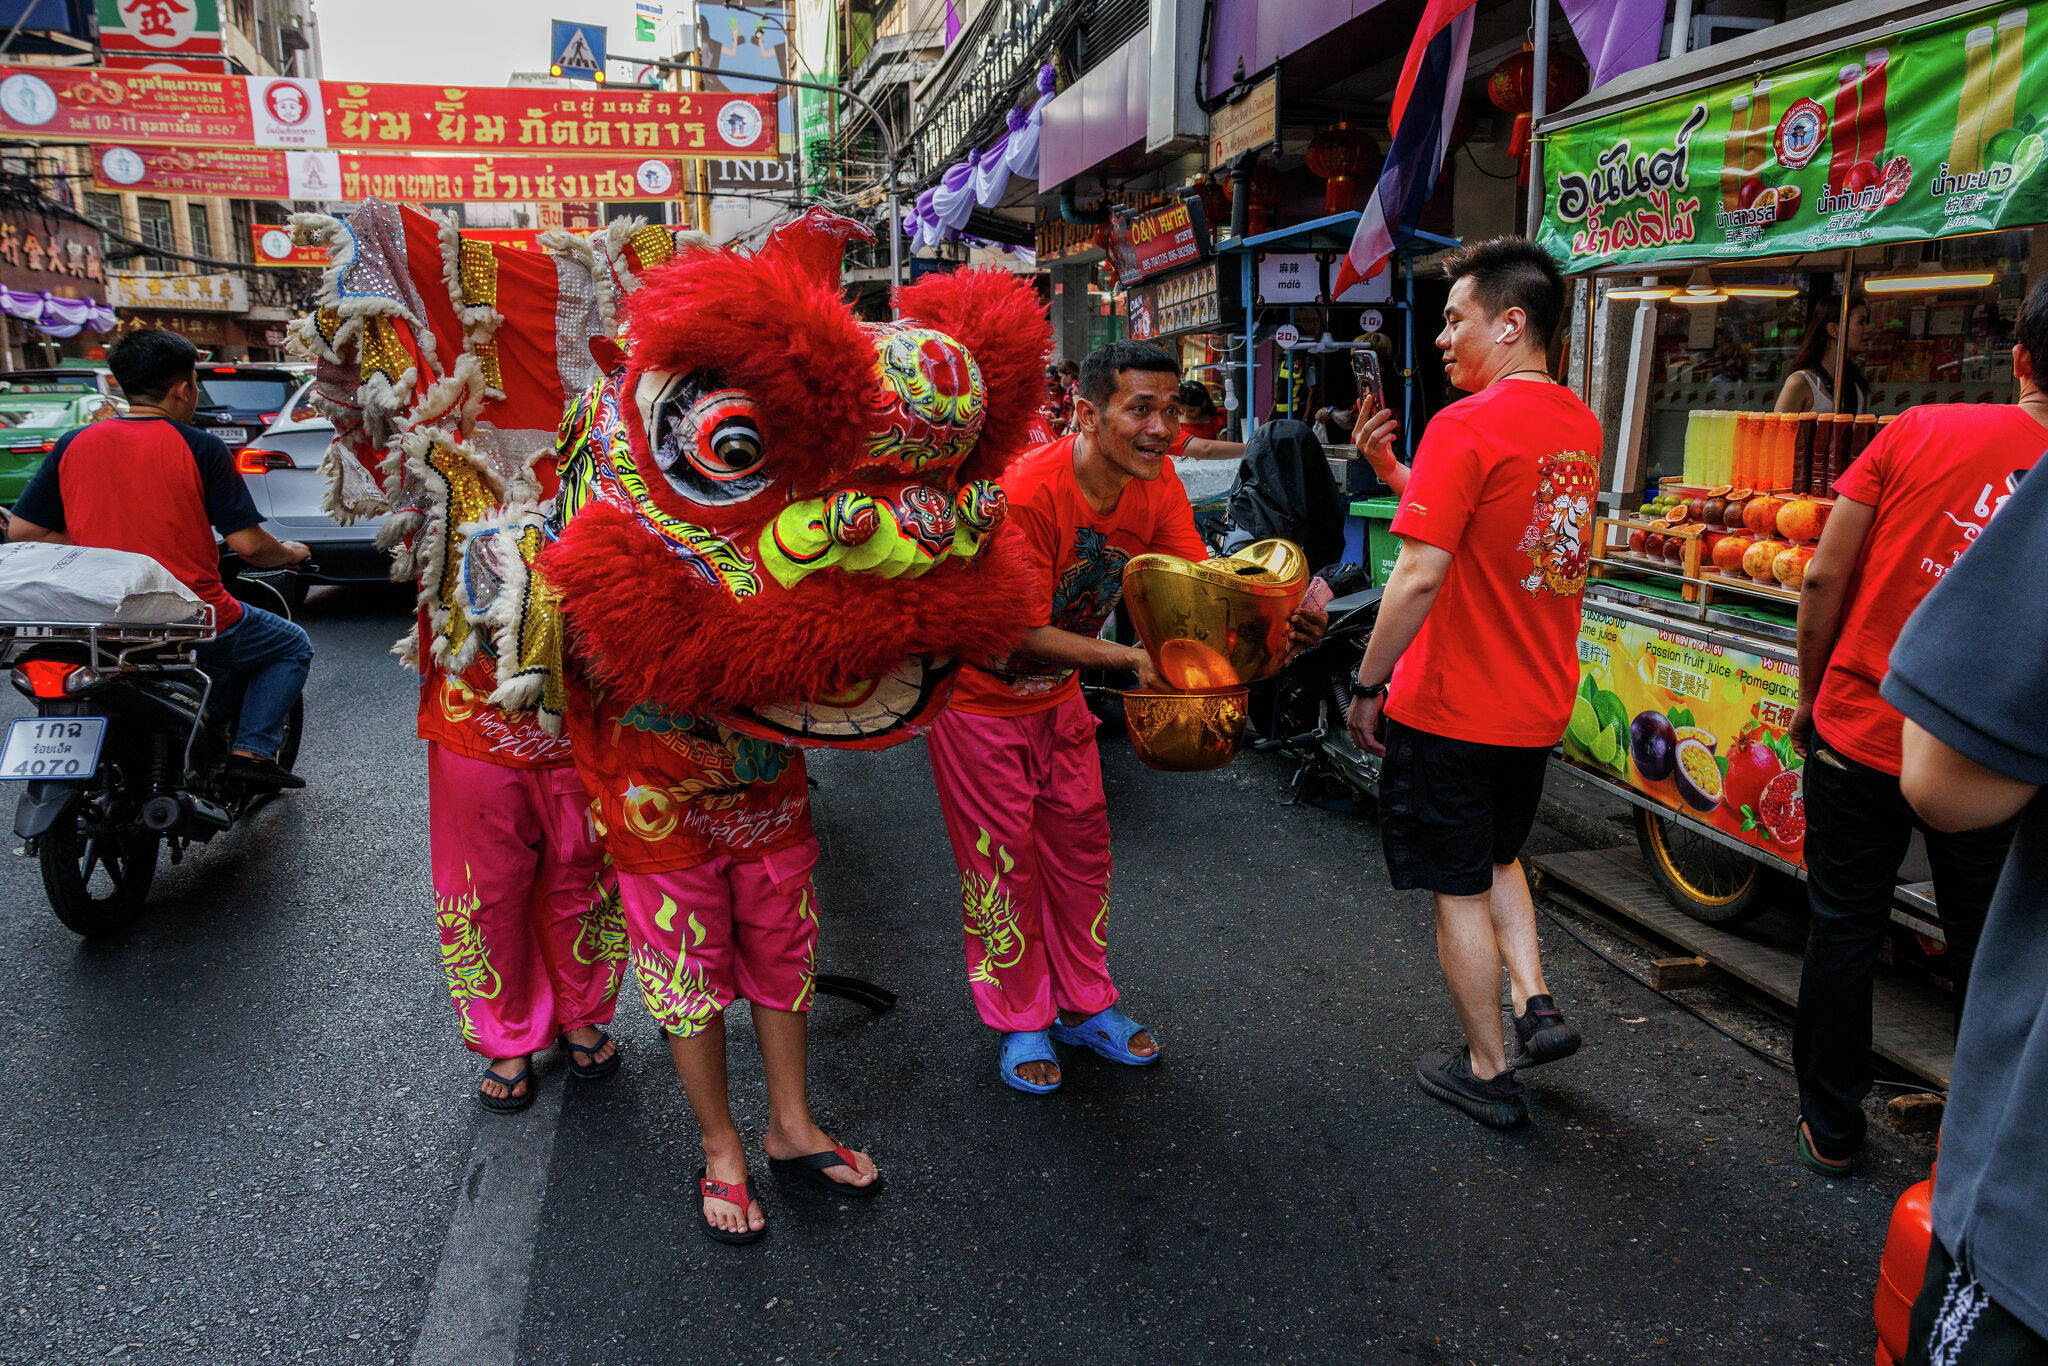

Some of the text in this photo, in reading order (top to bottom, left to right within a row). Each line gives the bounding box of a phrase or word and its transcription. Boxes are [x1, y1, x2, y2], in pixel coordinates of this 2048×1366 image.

[337, 84, 412, 144] ยิ้ม
[434, 87, 506, 145] ยิ้ม
[518, 107, 706, 148] ภัตตาคาร
[206, 124, 237, 136] 2567
[1558, 103, 1707, 222] อนันต์
[343, 157, 636, 199] ห้างขายทอง ฮั่วเซ่งเฮง
[1931, 163, 2013, 198] น้ำมะนาว
[1816, 184, 1886, 215] น้ำทับทิม
[1572, 190, 1700, 257] น้ำผลไม้
[1716, 200, 1777, 229] น้ำเสาวรส
[1946, 215, 1976, 229] Lime
[1131, 214, 1158, 245] O&N
[1804, 228, 1875, 246] Pomegranate
[1279, 263, 1300, 274] 麻辣
[1381, 567, 1393, 576] Org
[1580, 622, 1618, 643] ime juice
[1579, 641, 1611, 666] 青柠汁
[1646, 641, 1732, 678] Passion fruit juice
[1656, 664, 1710, 699] 百香果汁
[34, 722, 84, 739] 1กฉ
[473, 712, 512, 739] Happy
[33, 742, 73, 755] ร้อยเอ็ด
[13, 759, 81, 776] 4070
[683, 808, 720, 836] Happy
